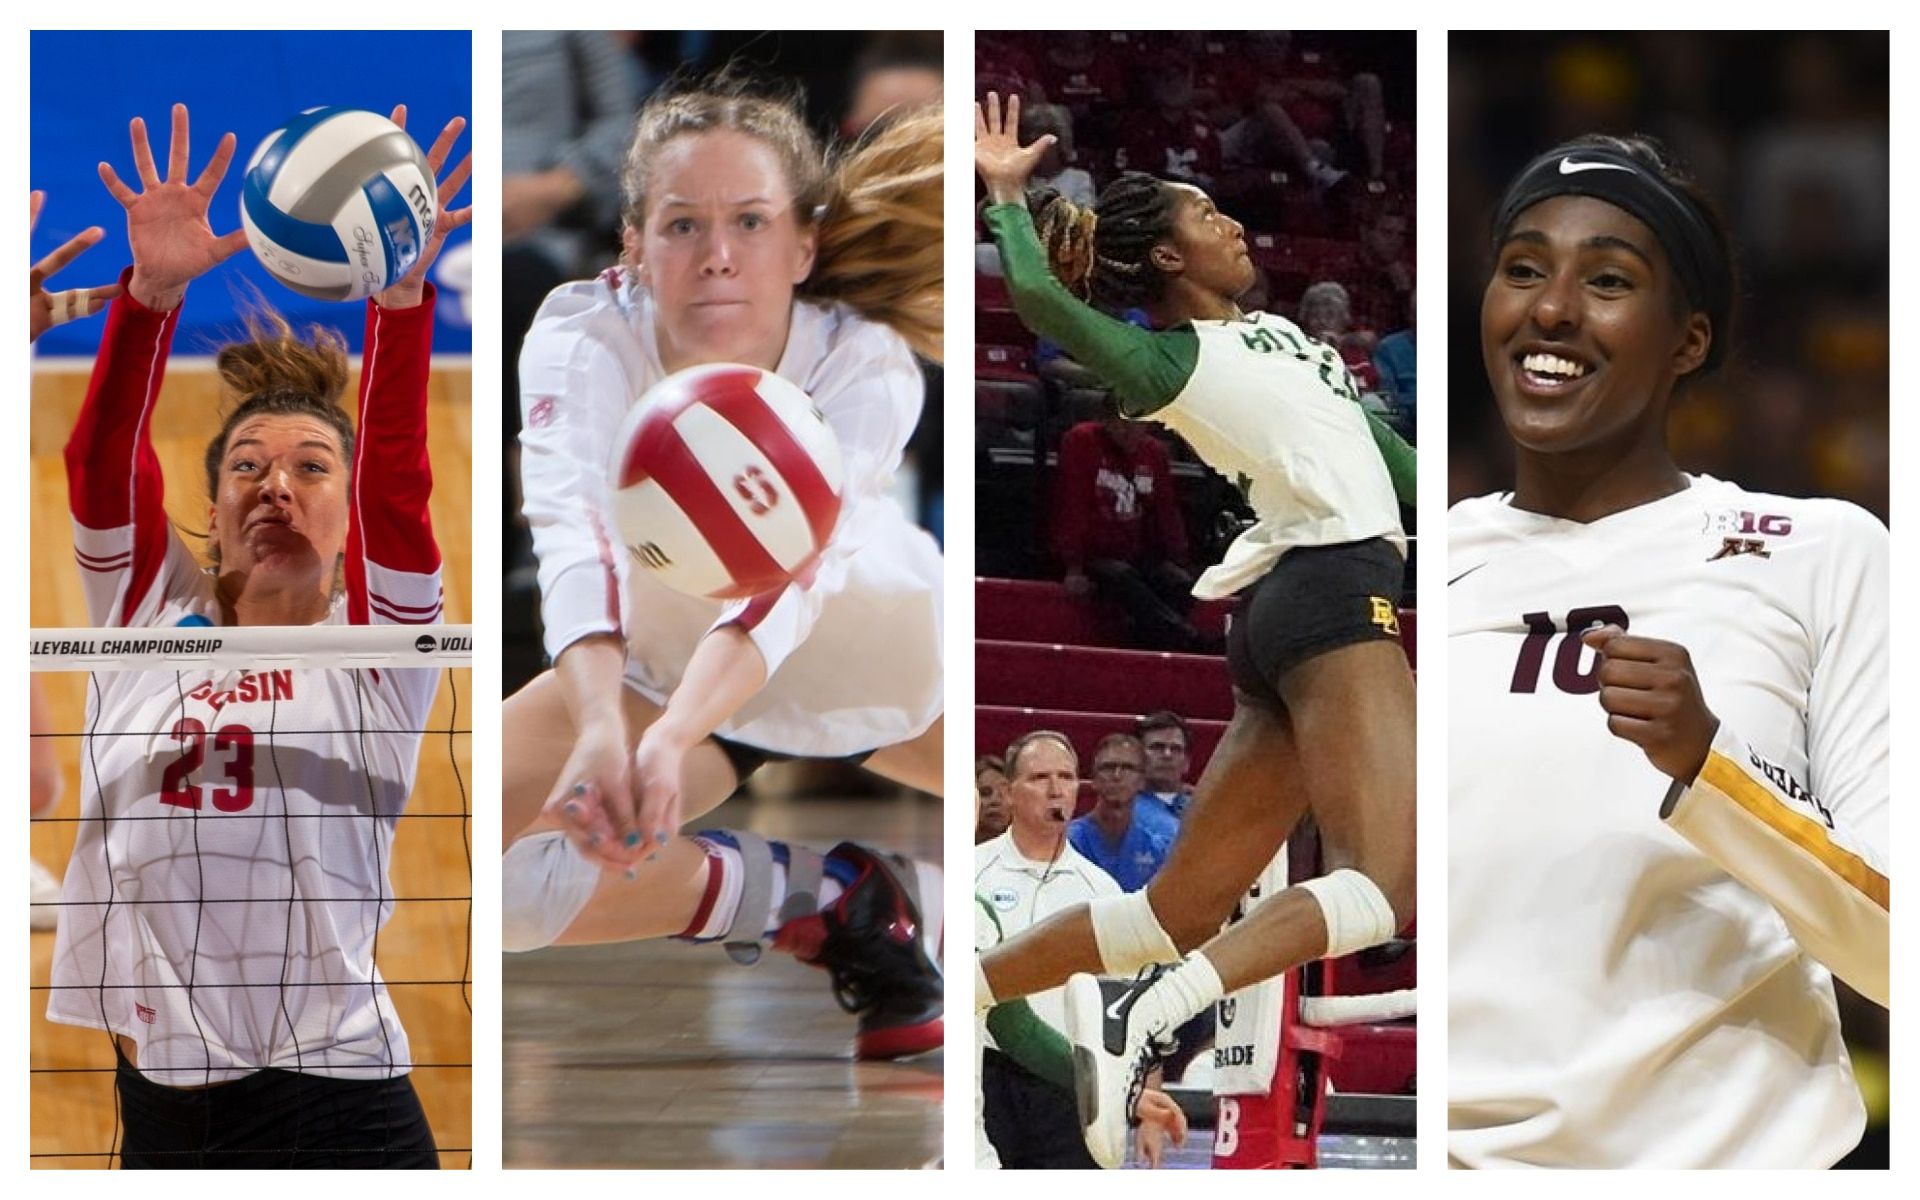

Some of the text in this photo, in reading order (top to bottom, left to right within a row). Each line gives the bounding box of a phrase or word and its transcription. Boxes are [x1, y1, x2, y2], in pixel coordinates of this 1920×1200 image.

[101, 639, 223, 655] CHAMPIONSHIP
[1510, 604, 1629, 695] 10
[160, 717, 254, 813] 23
